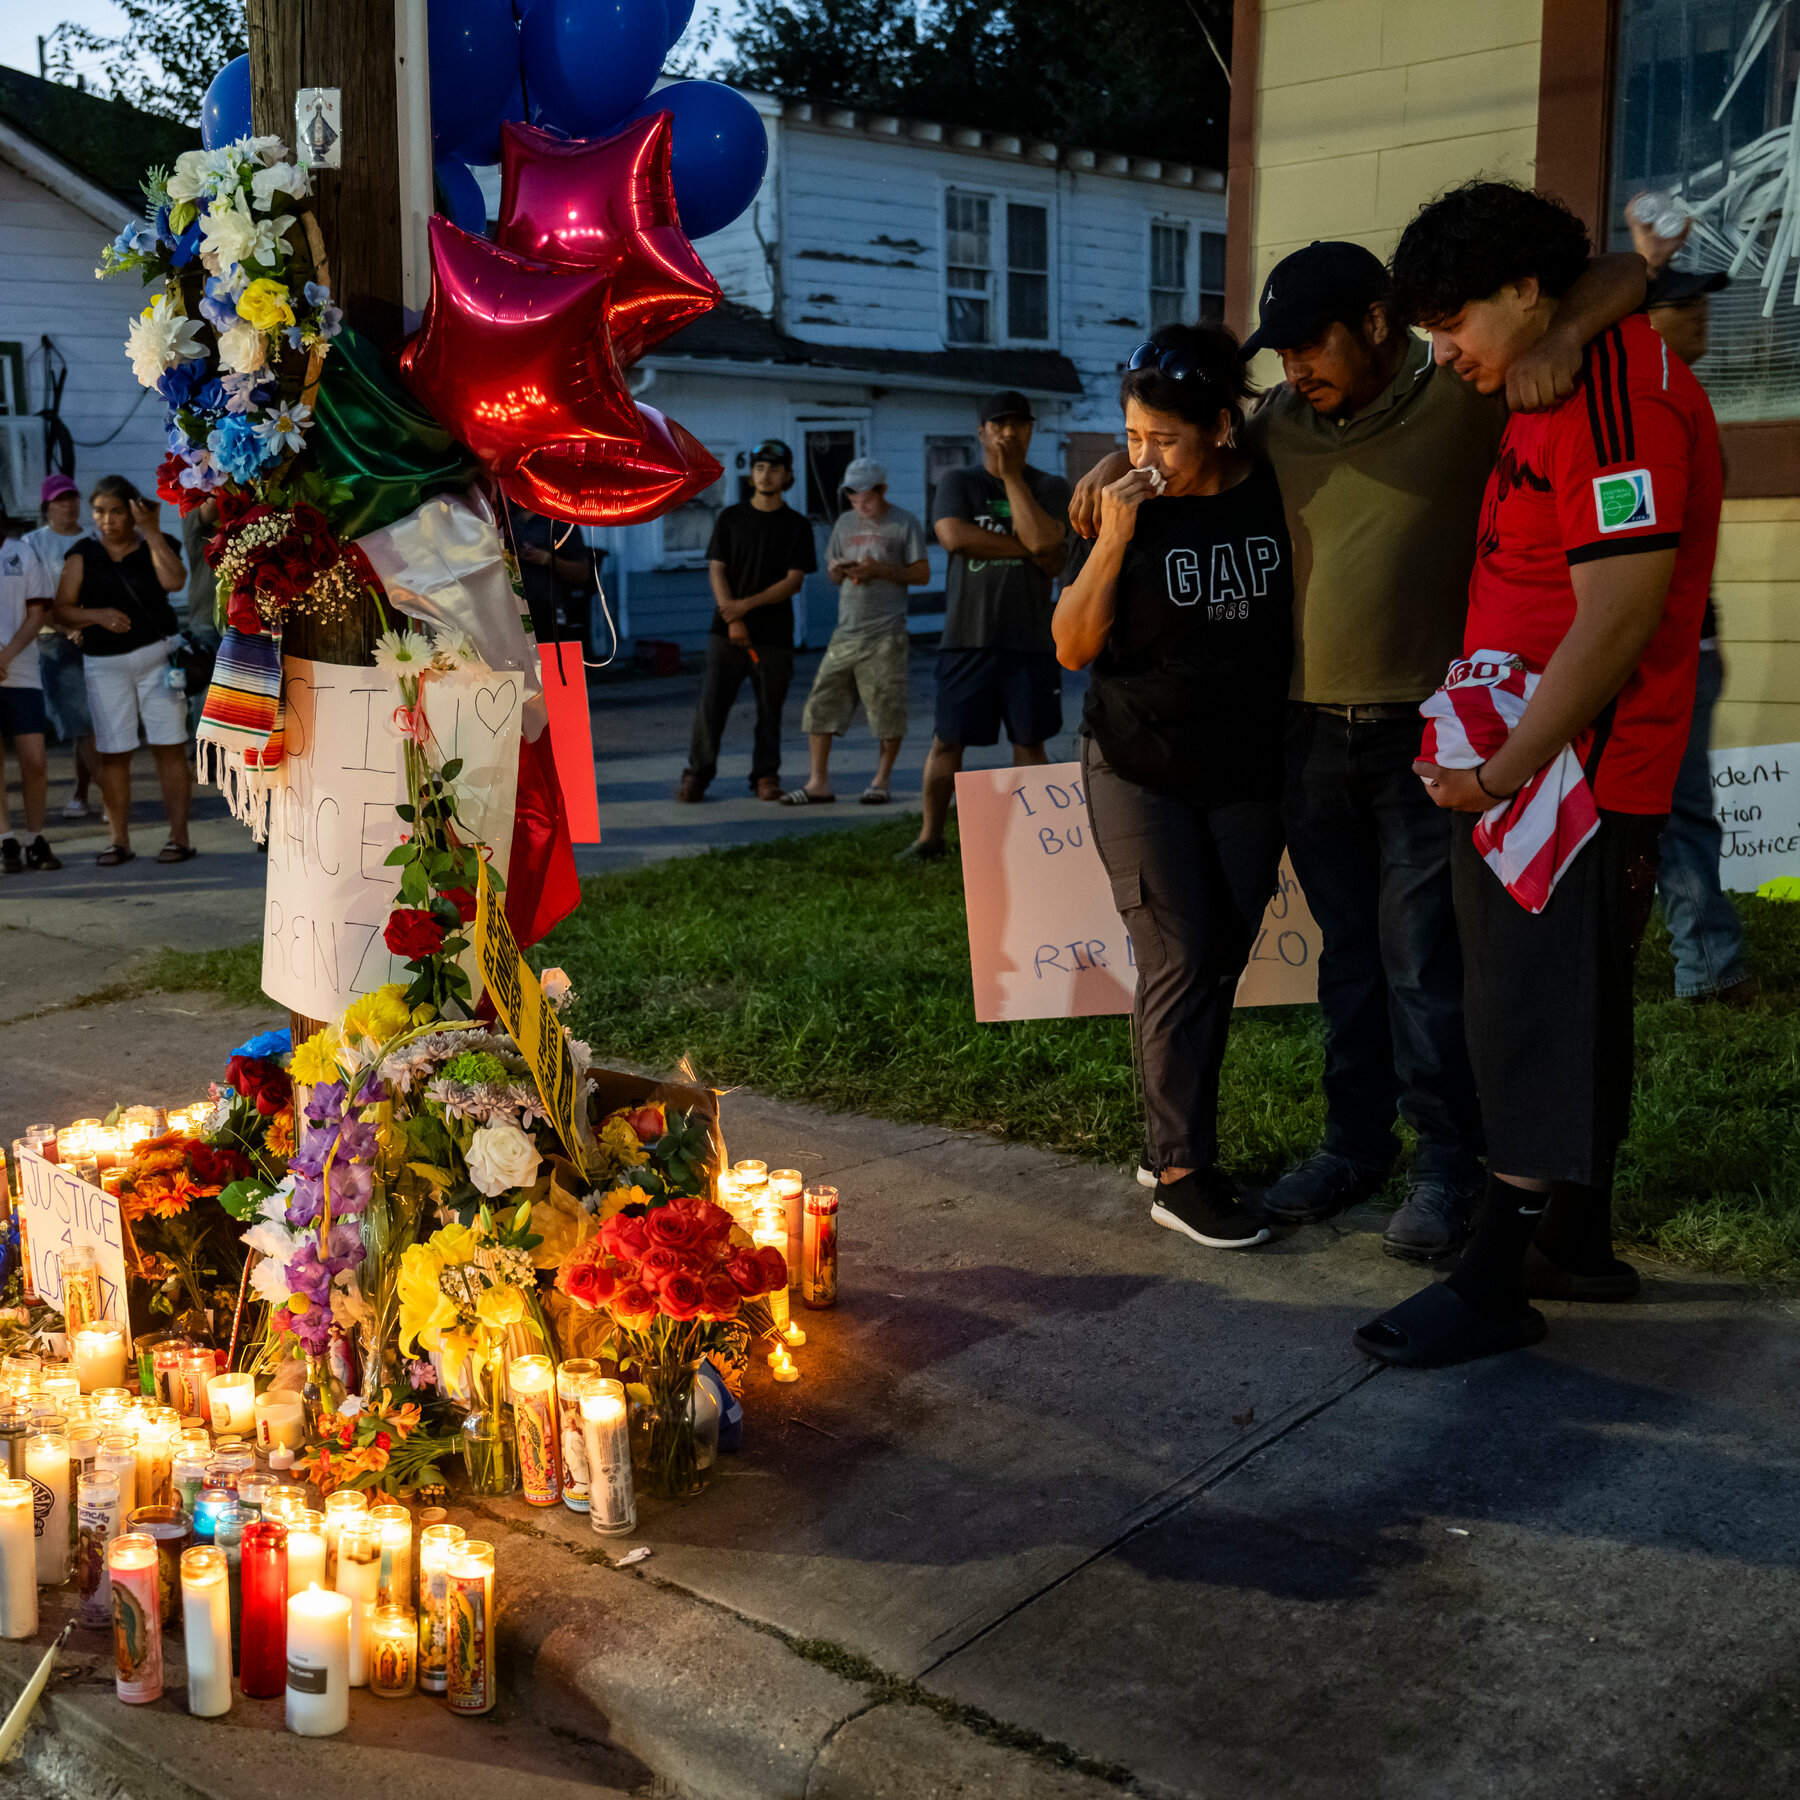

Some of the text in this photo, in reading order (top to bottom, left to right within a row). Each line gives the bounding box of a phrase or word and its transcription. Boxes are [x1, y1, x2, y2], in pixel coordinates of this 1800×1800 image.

[1165, 536, 1280, 606] GAP
[1207, 600, 1250, 622] 1969
[271, 785, 396, 884] ACE
[1038, 825, 1093, 855] BU
[1716, 801, 1762, 823] tion
[269, 900, 381, 994] RENZ
[21, 1155, 120, 1249] JUSTICE
